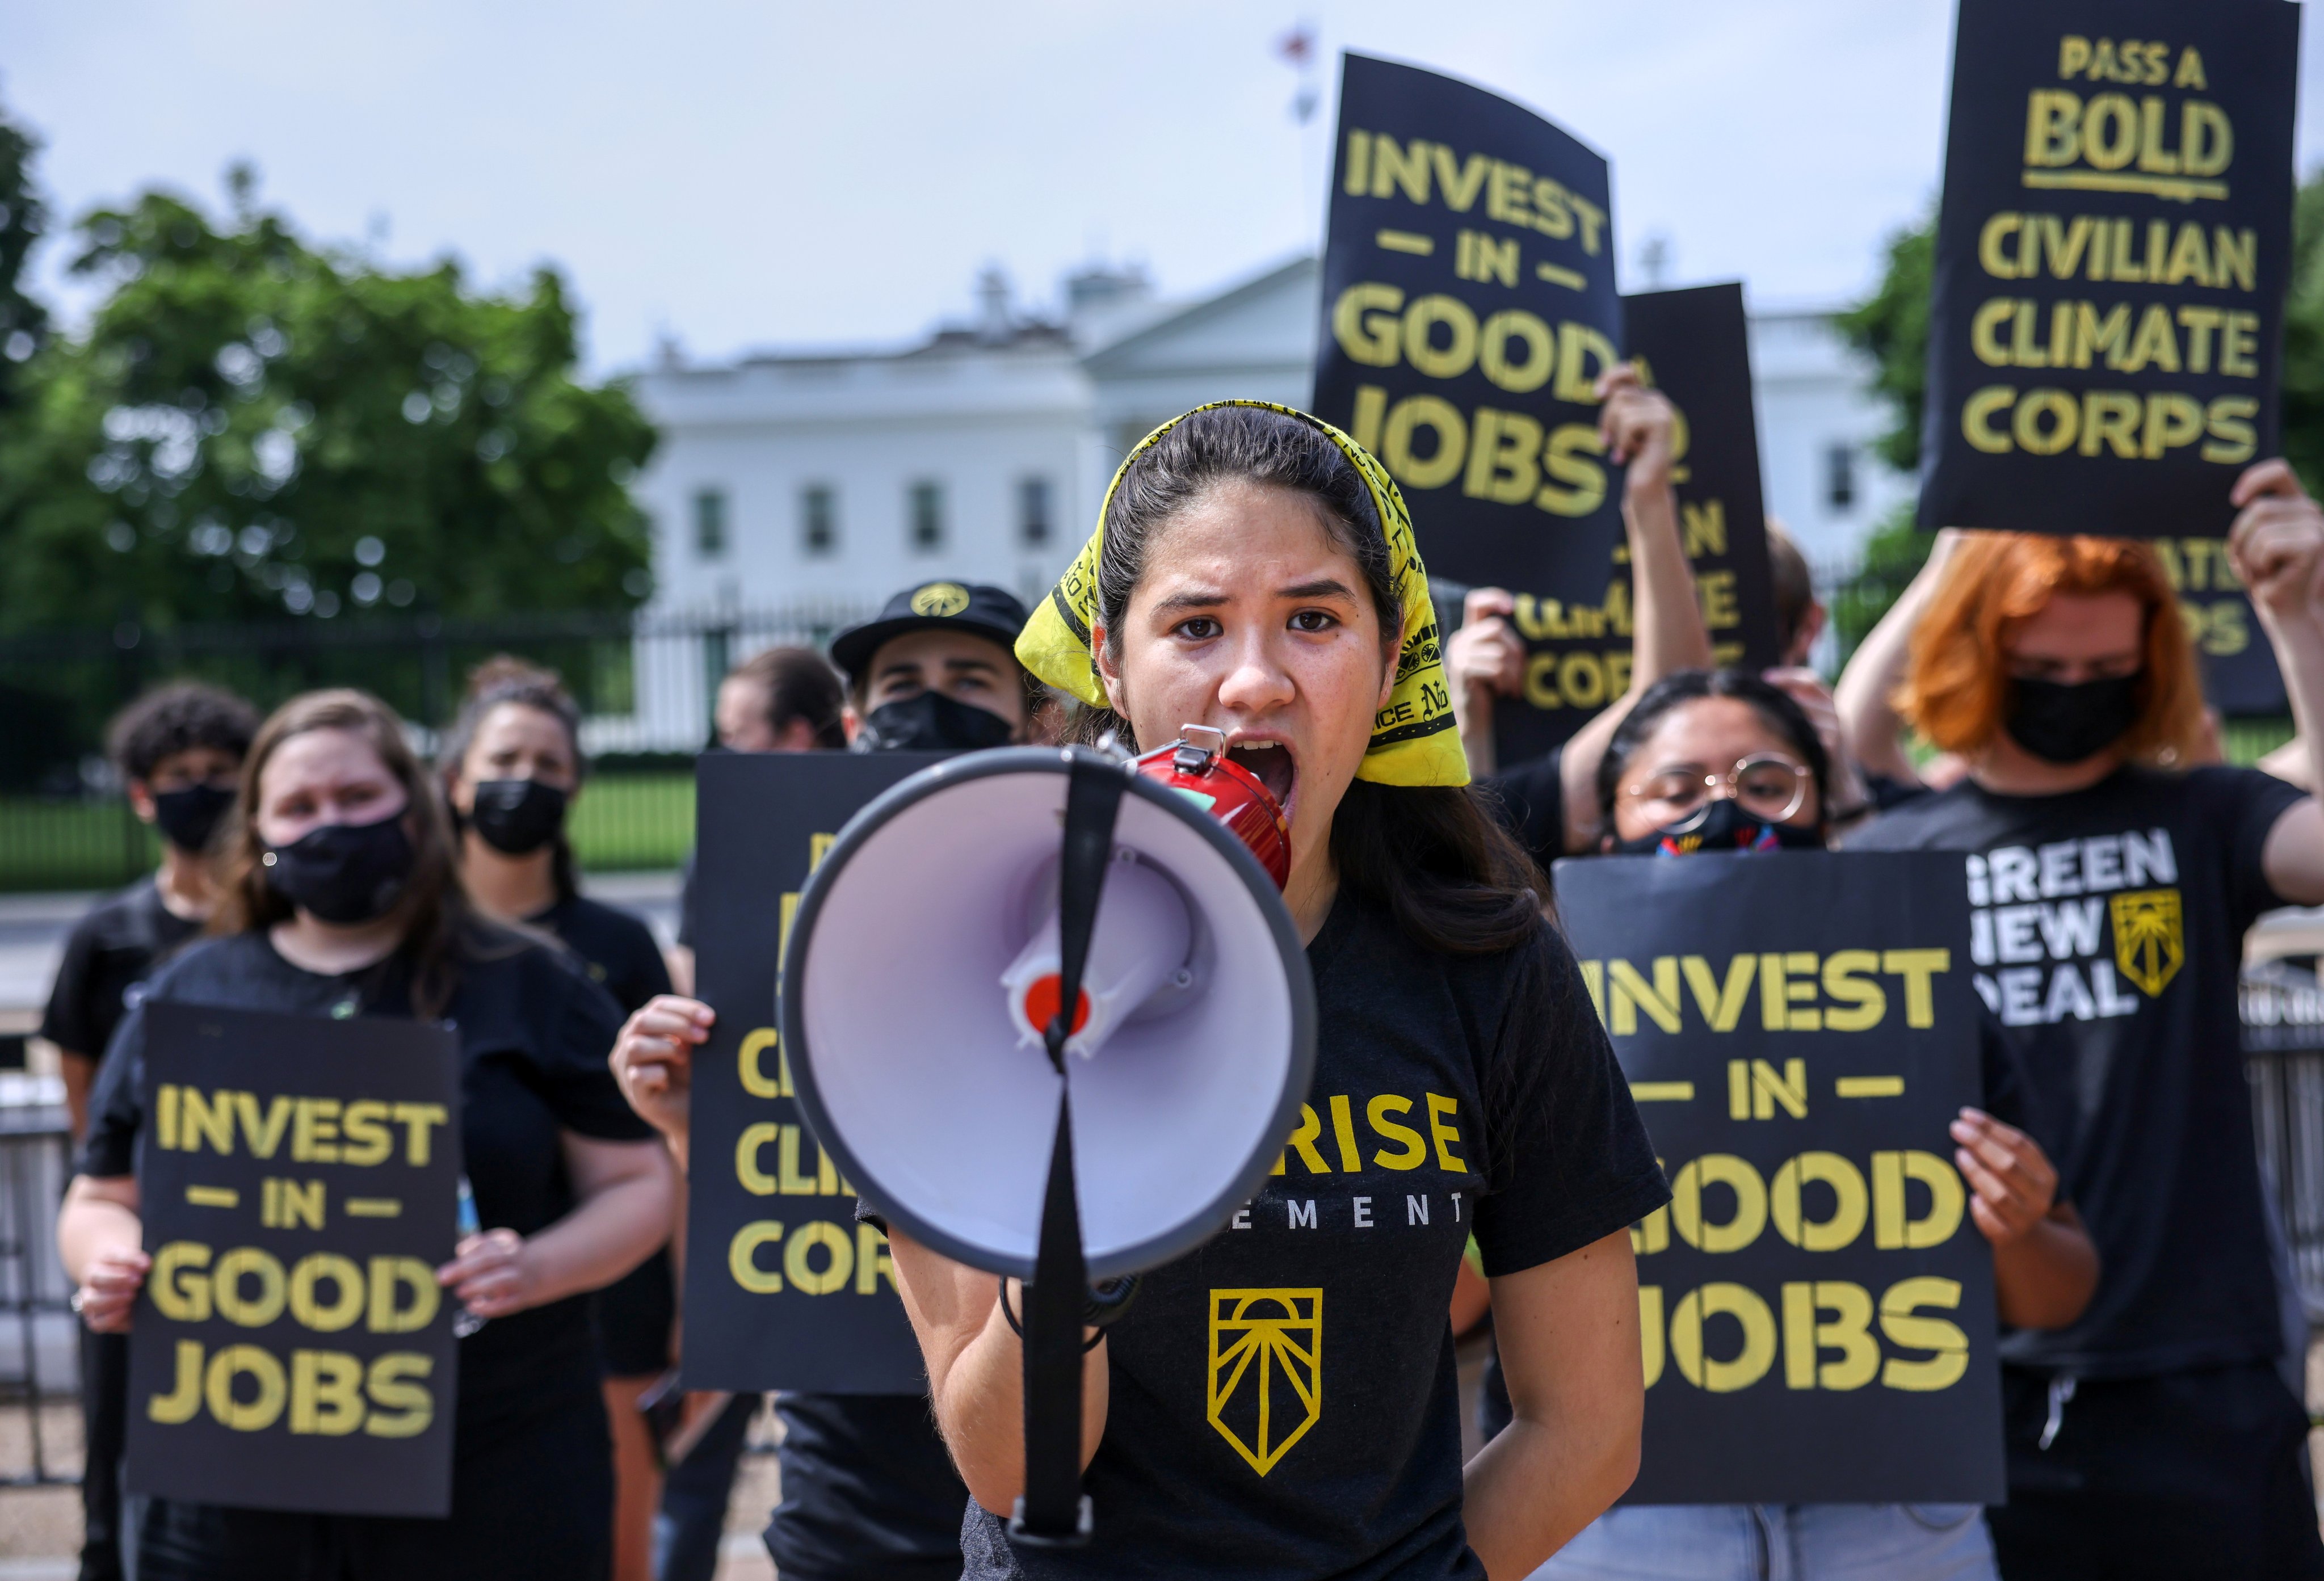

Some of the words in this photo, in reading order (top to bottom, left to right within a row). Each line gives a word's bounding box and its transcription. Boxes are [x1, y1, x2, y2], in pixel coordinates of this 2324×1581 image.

[2058, 35, 2170, 84] PASS
[2174, 44, 2207, 90] A
[2022, 87, 2234, 176] BOLD
[1343, 128, 1607, 257] INVEST
[1455, 229, 1521, 288] IN
[1978, 211, 2258, 292] CIVILIAN
[1332, 281, 1619, 405] GOOD
[1970, 296, 2260, 378] CLIMATE
[1961, 384, 2260, 465] CORPS
[155, 1083, 449, 1167] INVEST
[1728, 1057, 1809, 1120] IN
[260, 1177, 327, 1231] IN
[148, 1240, 442, 1334] GOOD
[147, 1340, 435, 1438] JOBS
